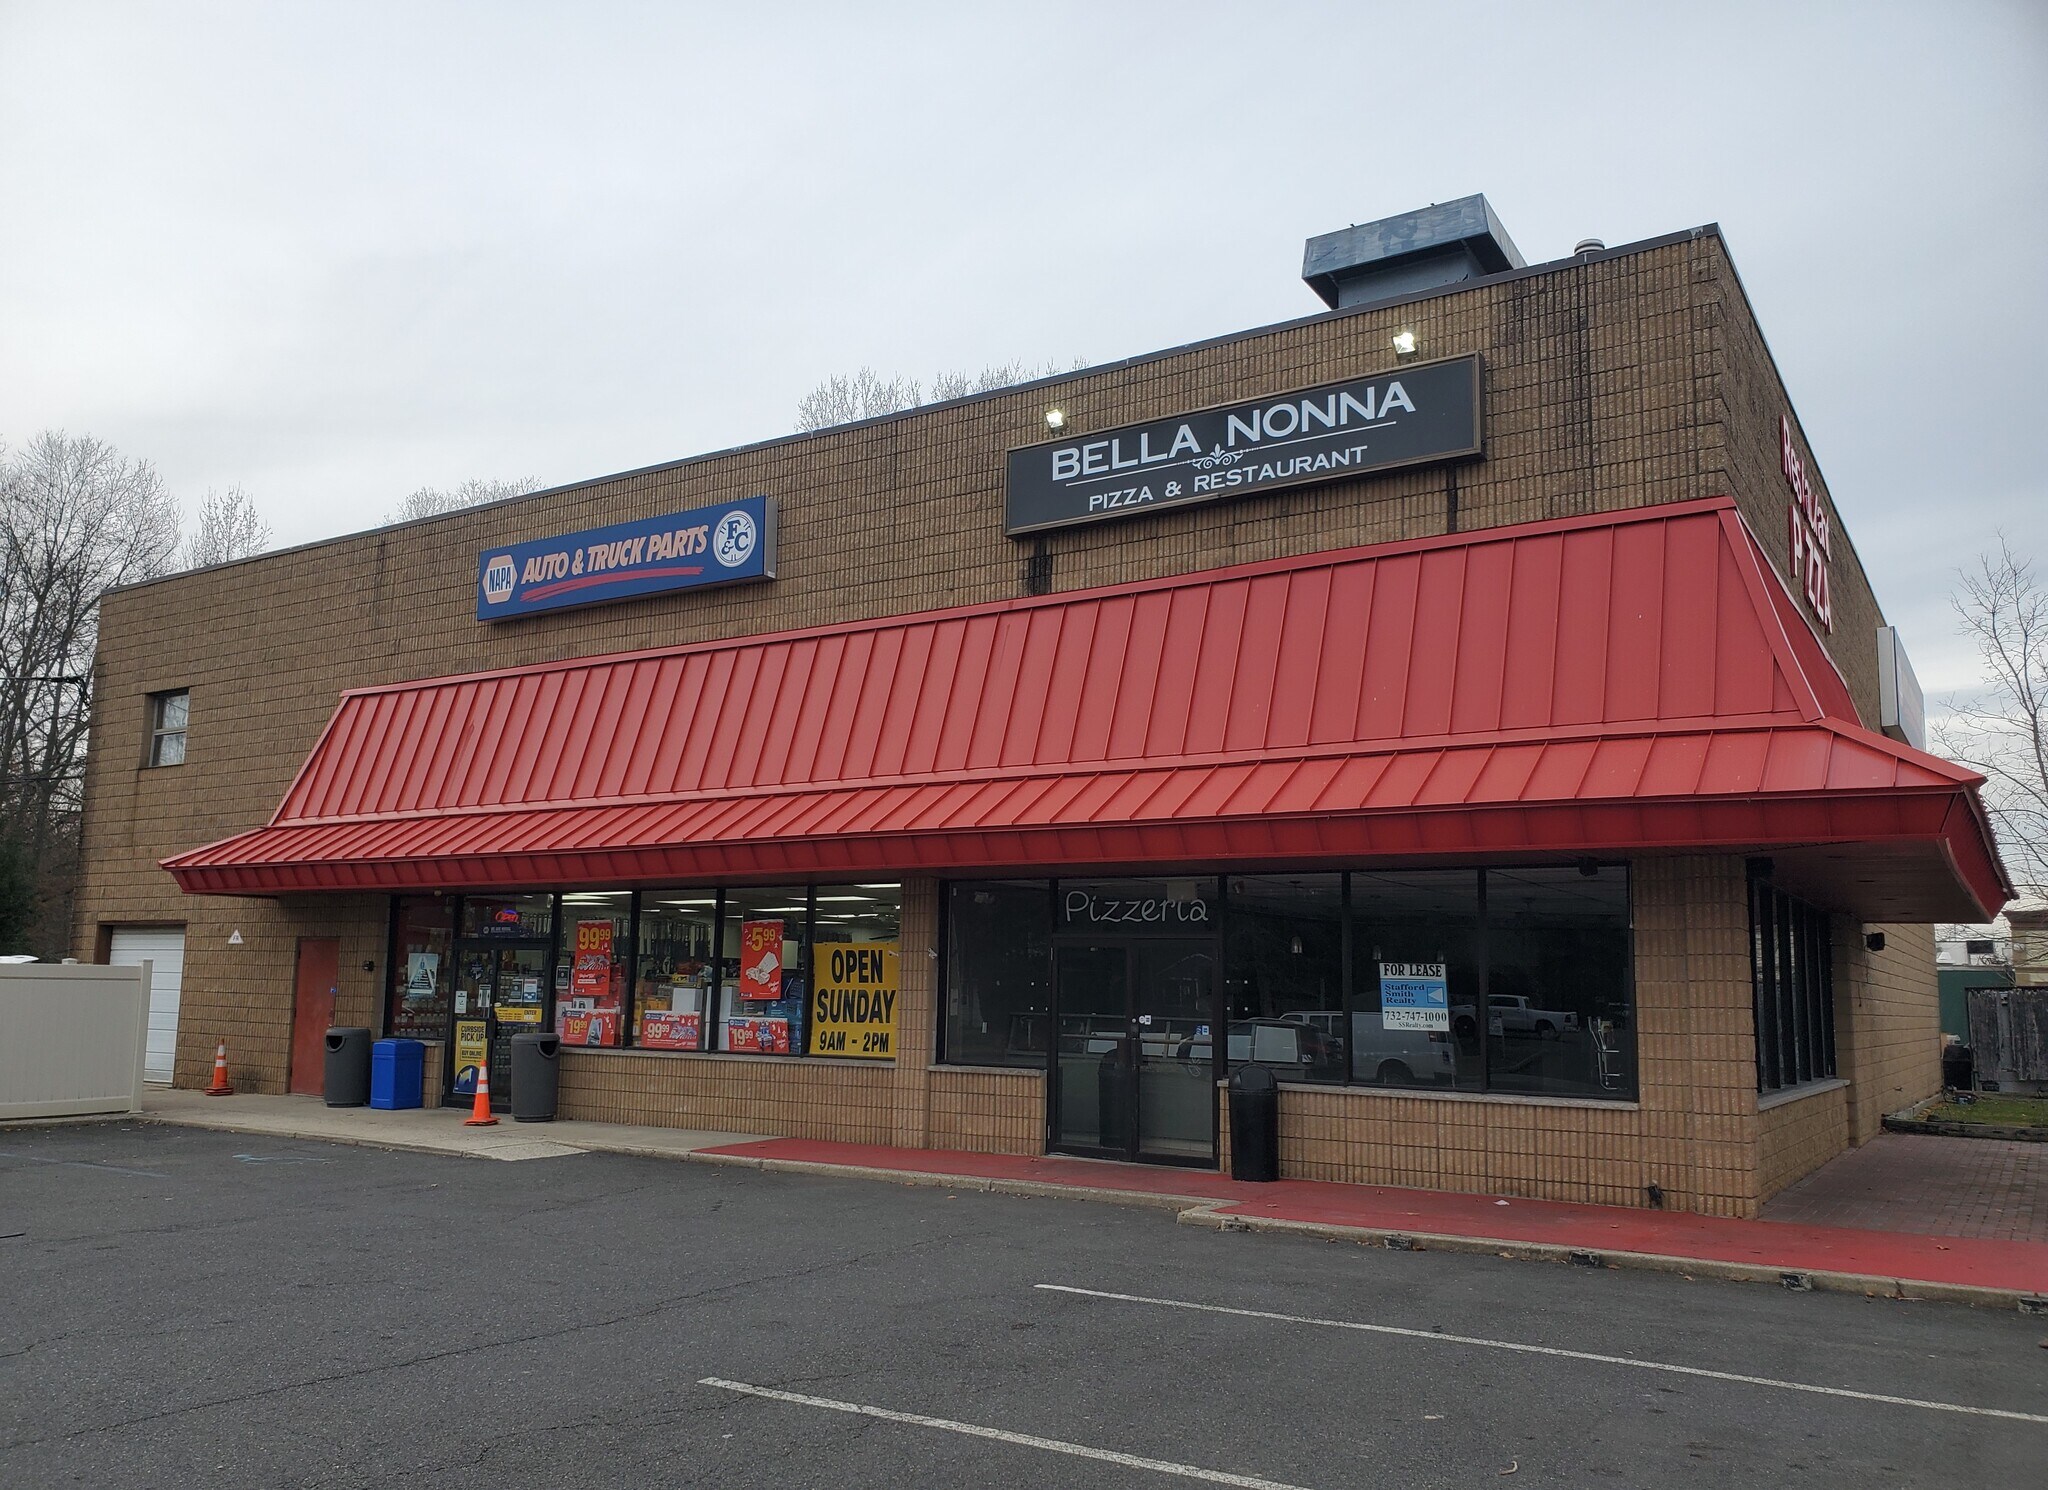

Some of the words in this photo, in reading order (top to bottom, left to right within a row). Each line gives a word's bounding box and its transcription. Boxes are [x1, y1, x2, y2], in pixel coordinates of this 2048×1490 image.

[1051, 424, 1201, 482] BELLA
[1227, 381, 1416, 446] NONNA
[1088, 485, 1154, 512] PIZZA
[1165, 481, 1182, 497] &
[1193, 445, 1368, 493] RESTAURANT
[488, 566, 512, 593] NAPA
[520, 551, 570, 585] AUTO
[571, 548, 585, 576] &
[587, 535, 646, 573] TRUCK
[646, 524, 710, 563] PARTS
[1065, 890, 1209, 922] Pizzeria
[831, 949, 884, 984] OPEN
[1383, 963, 1405, 976] FOR
[1408, 964, 1442, 978] LEASE
[1384, 983, 1425, 991] Stafford
[1385, 990, 1414, 998] Smith
[816, 988, 897, 1024] SUNDAY
[1385, 997, 1417, 1005] Realty
[1384, 1010, 1447, 1022] 732-747-1000
[460, 1032, 475, 1042] PICK
[476, 1032, 485, 1042] UP
[819, 1031, 847, 1051] 9AM
[862, 1031, 890, 1053] 2PM
